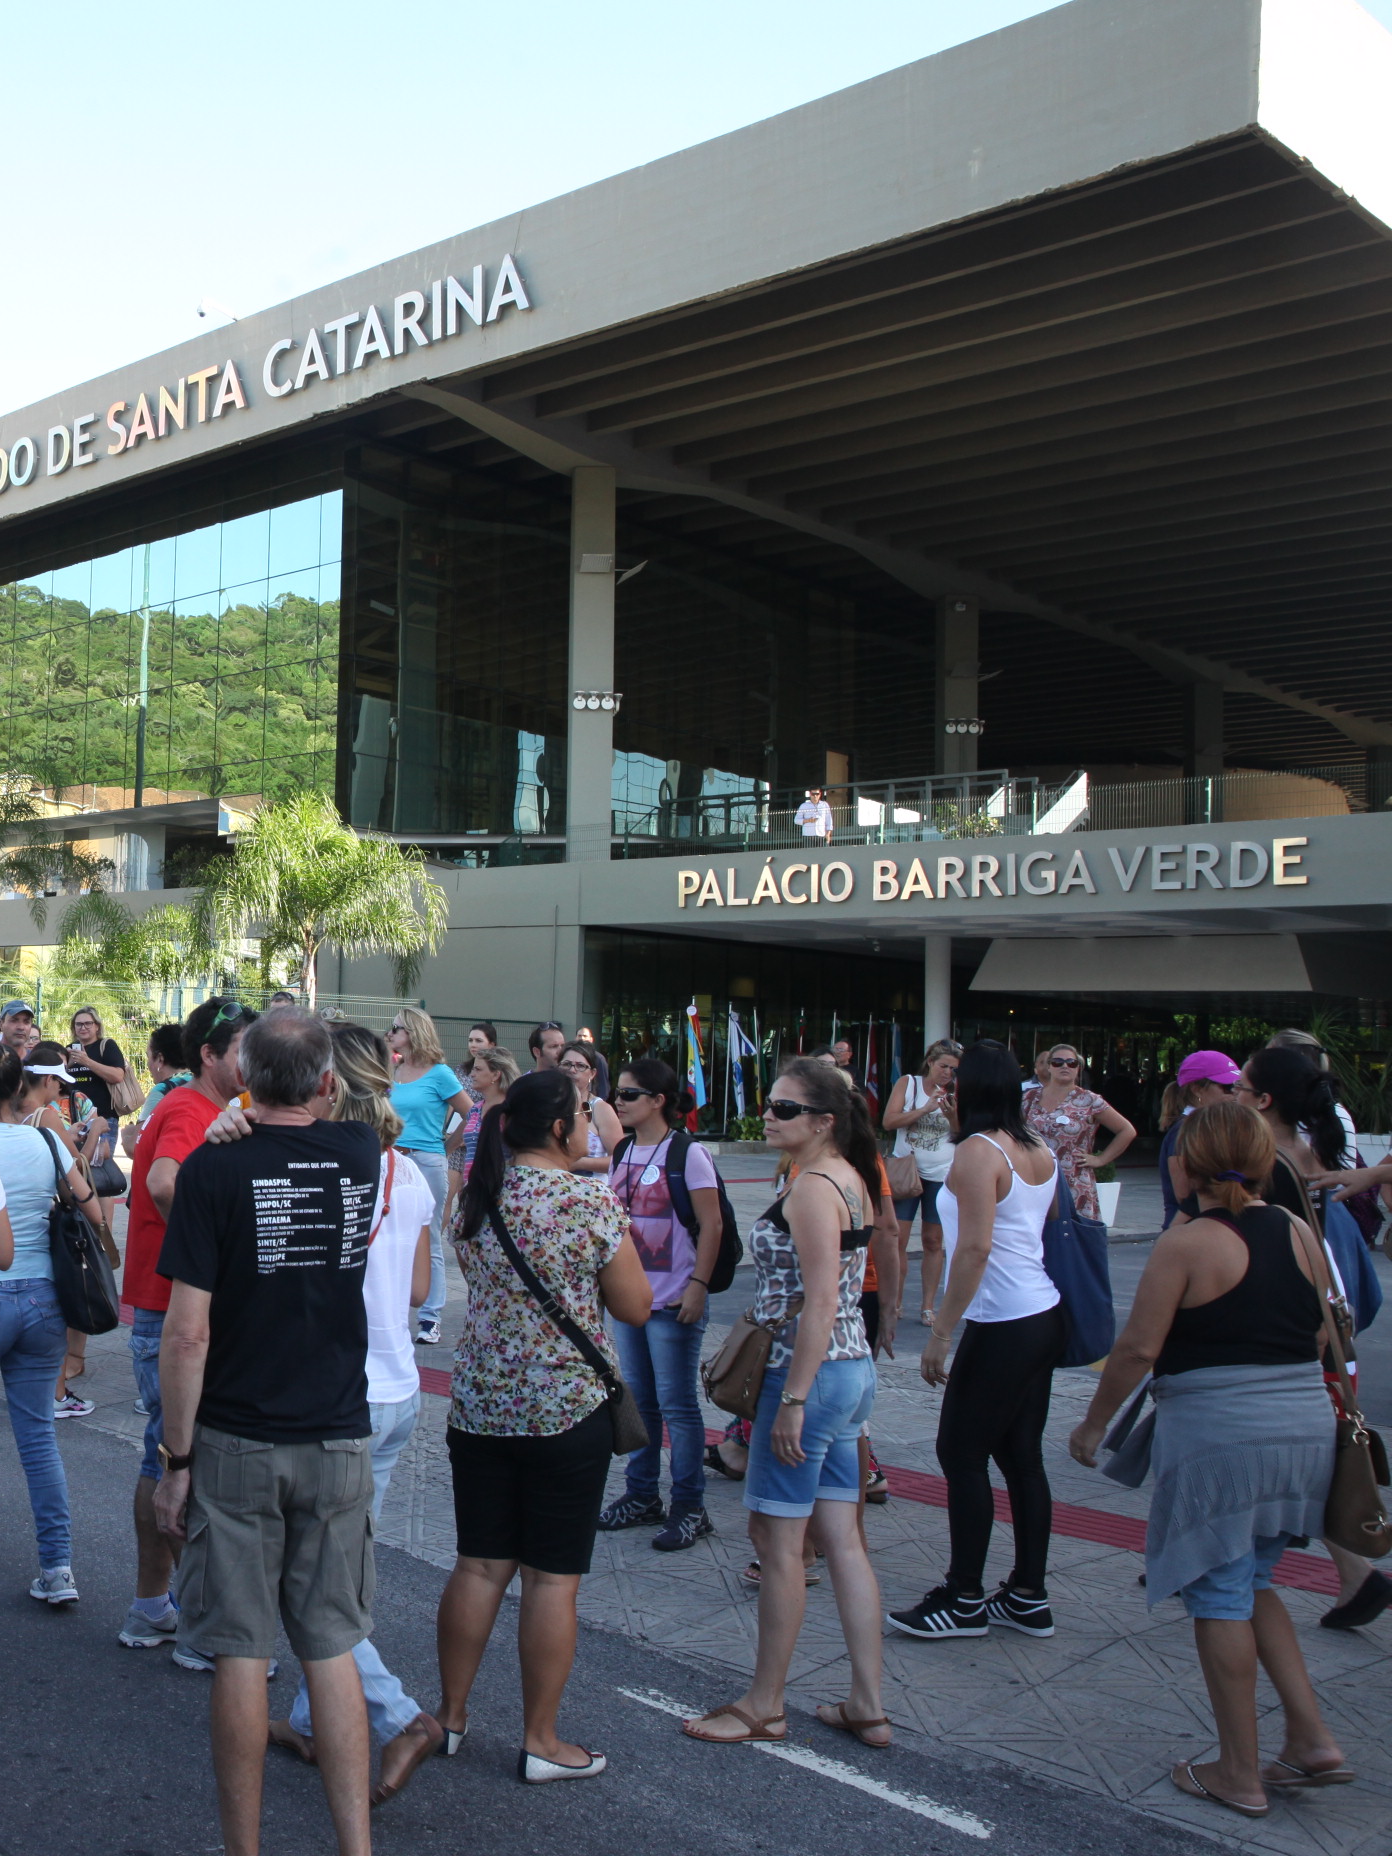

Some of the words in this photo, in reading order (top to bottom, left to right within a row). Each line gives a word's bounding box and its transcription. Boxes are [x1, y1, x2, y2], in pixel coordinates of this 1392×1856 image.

[47, 412, 96, 477] DE
[107, 359, 247, 456] SANTA
[263, 253, 531, 398] CATARINA
[678, 856, 854, 908] PALÁCIO
[873, 849, 1098, 901] BARRIGA
[1108, 837, 1308, 892] VERDE
[252, 1178, 291, 1187] SINDASPISC
[340, 1177, 351, 1185] CTB
[255, 1200, 292, 1210] SINPOL/SC
[256, 1216, 292, 1225] SINTAEMA
[257, 1238, 287, 1247] SINTE/SC
